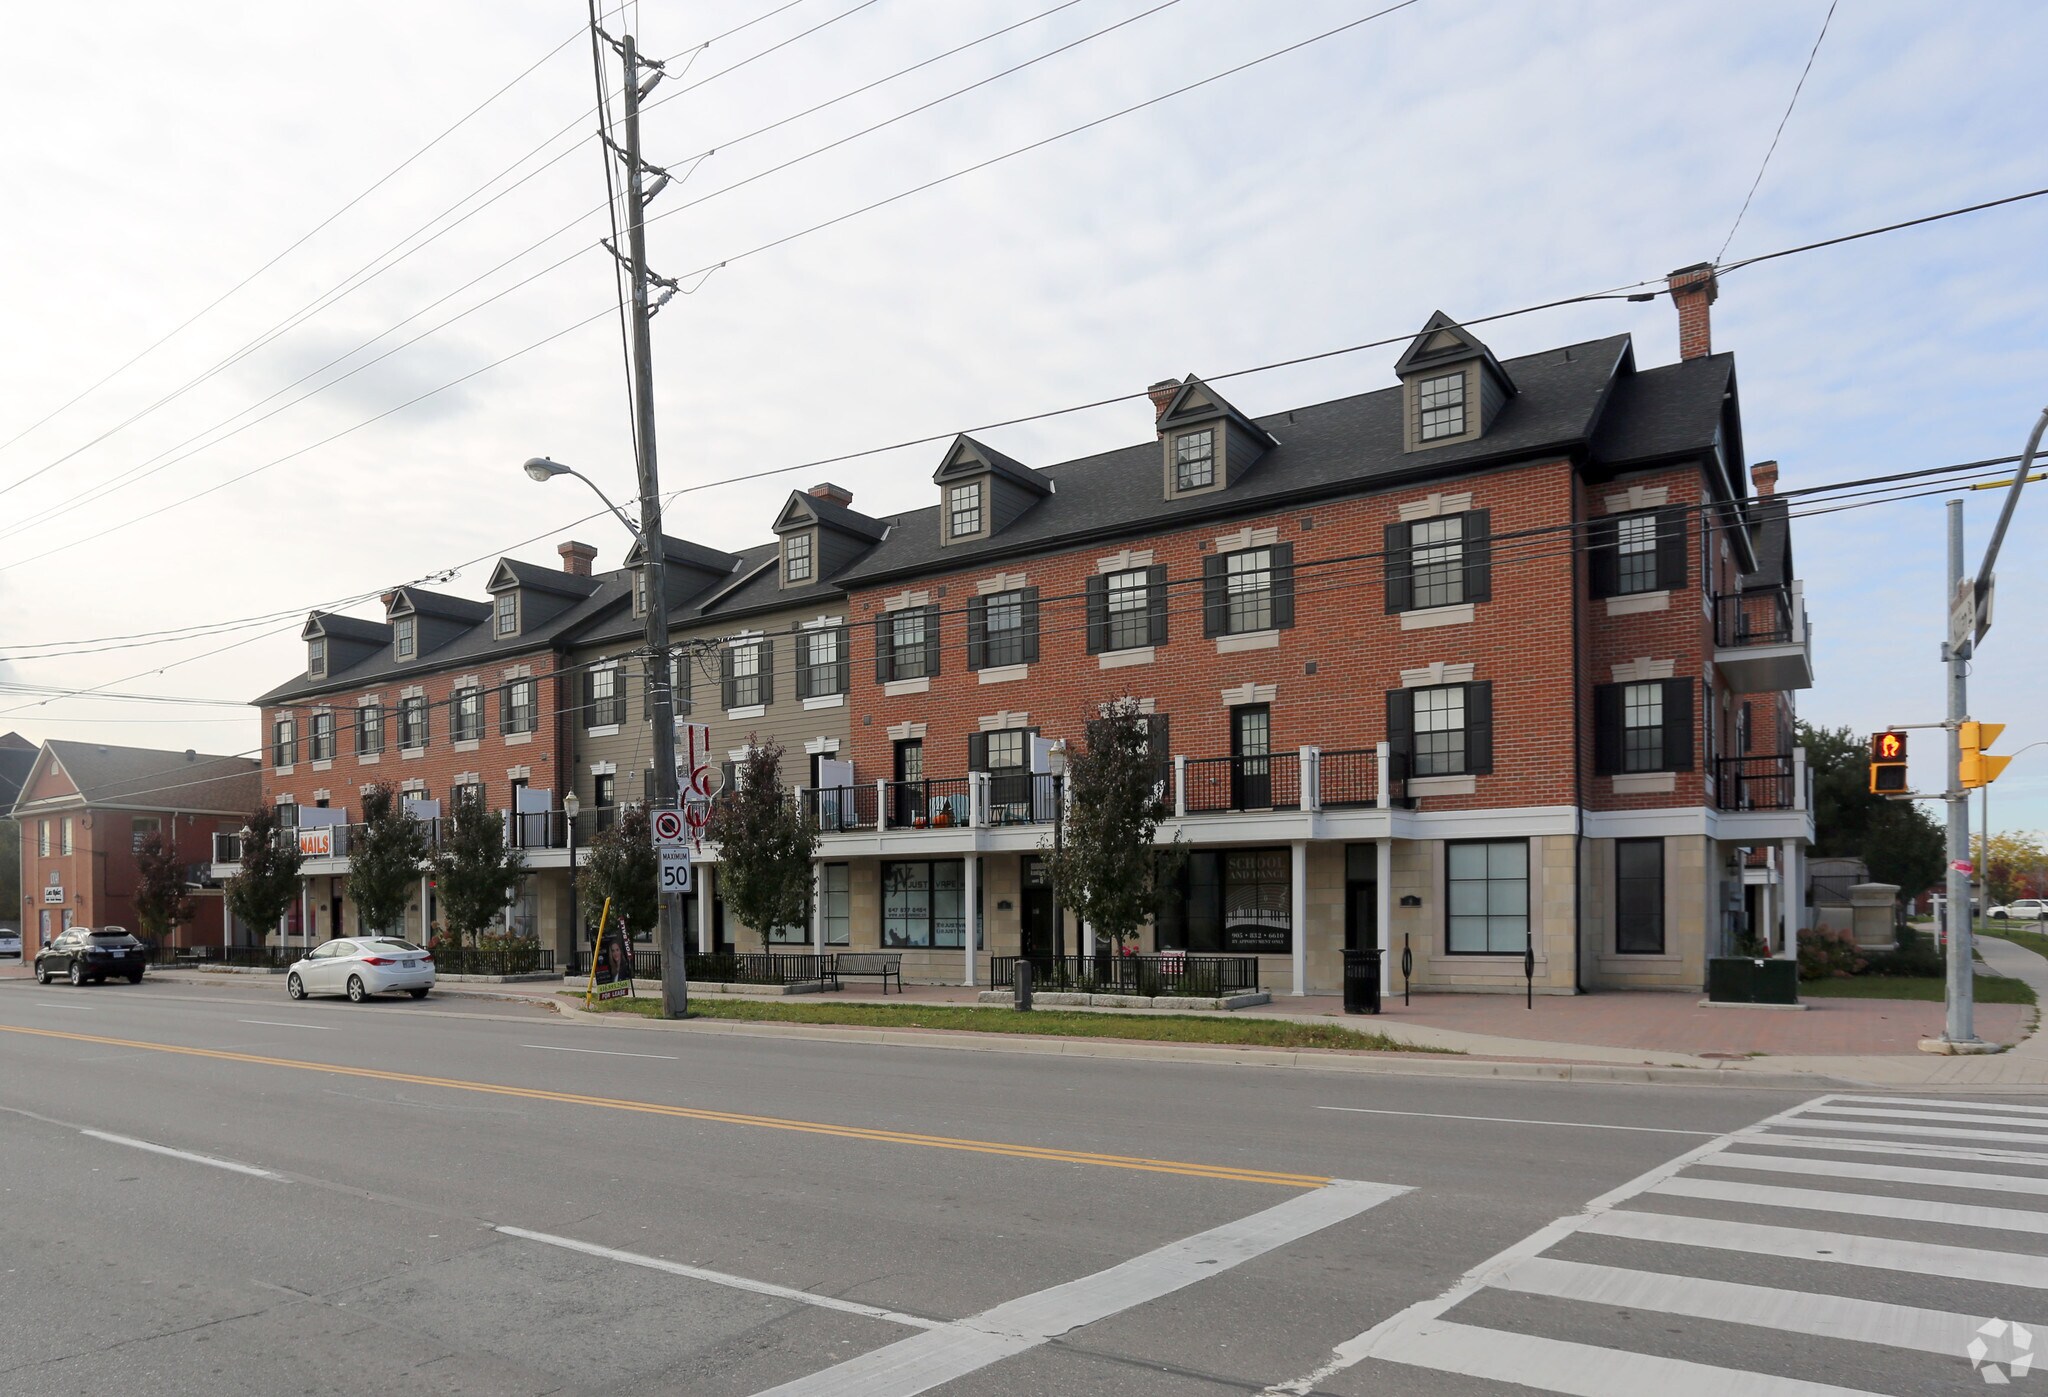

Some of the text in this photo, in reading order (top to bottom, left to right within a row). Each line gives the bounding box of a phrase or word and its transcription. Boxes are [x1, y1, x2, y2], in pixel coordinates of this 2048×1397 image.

[301, 835, 328, 853] NAILS
[1229, 857, 1285, 869] SCHOOL
[664, 866, 687, 886] 50
[1231, 870, 1285, 879] AND DANCE
[908, 880, 928, 888] JUST
[935, 880, 957, 888] VAPE
[620, 920, 632, 956] FOR SALE
[601, 989, 625, 999] FOR LEASE
